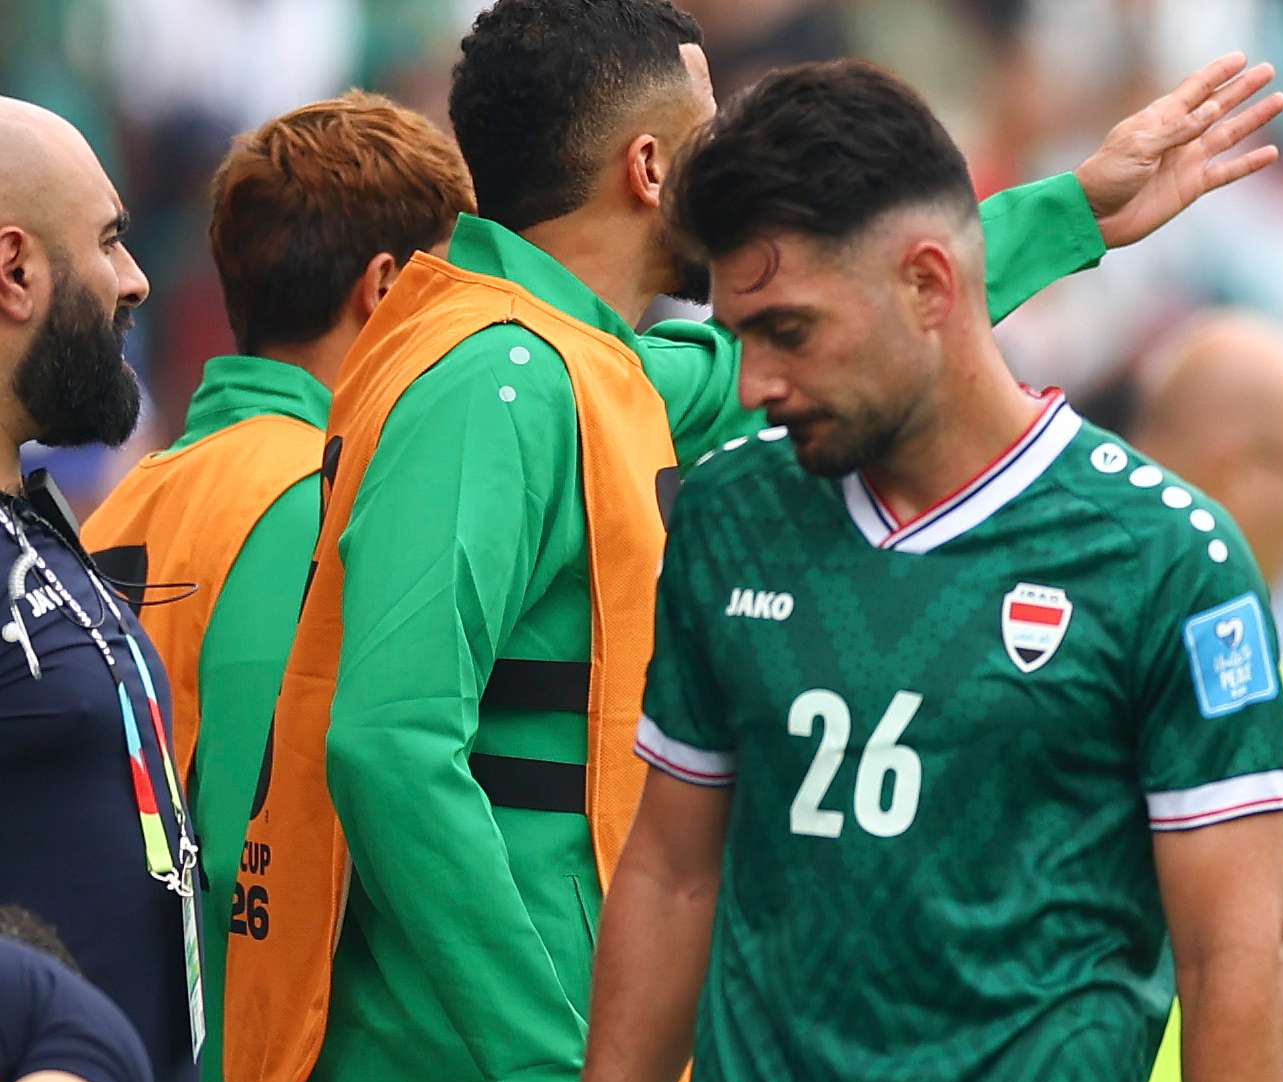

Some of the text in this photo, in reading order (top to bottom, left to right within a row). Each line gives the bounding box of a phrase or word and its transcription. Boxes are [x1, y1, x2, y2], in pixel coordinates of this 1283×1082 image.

[725, 587, 794, 621] JAKO
[788, 688, 924, 838] 26
[230, 881, 270, 941] 26
